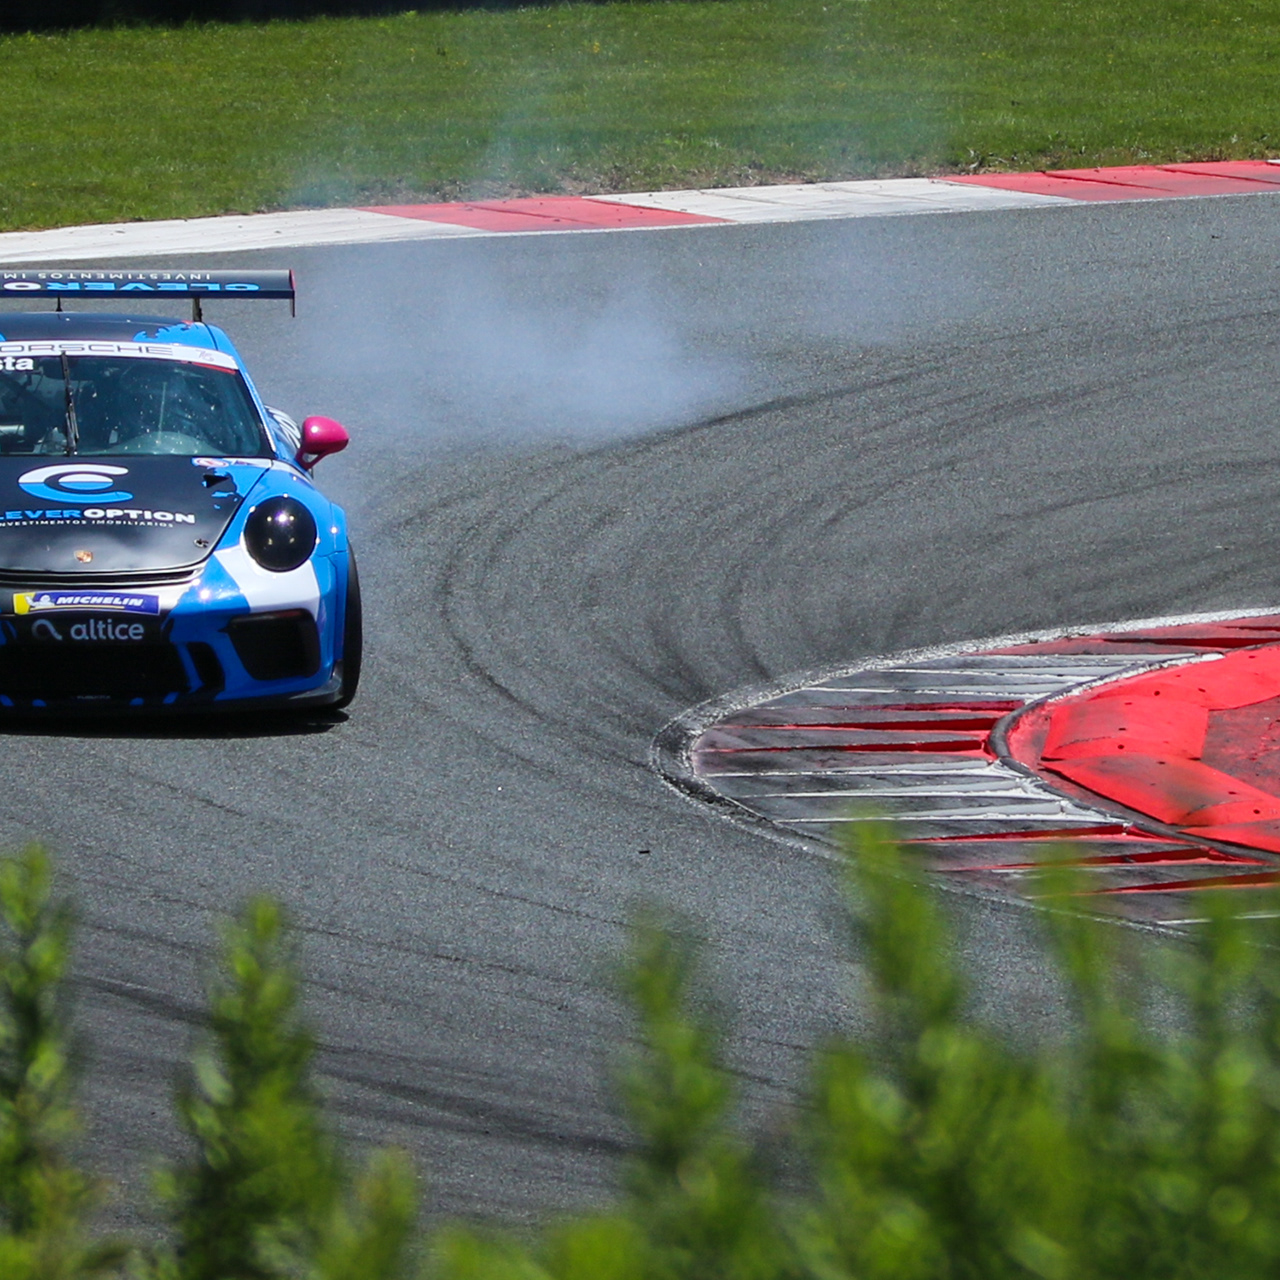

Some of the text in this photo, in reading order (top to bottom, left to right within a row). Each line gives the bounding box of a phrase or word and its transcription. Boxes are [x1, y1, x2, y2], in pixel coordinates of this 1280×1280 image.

[37, 272, 211, 280] INVESTIMENTOS
[56, 595, 144, 607] MICHELIN
[70, 618, 145, 640] altice
